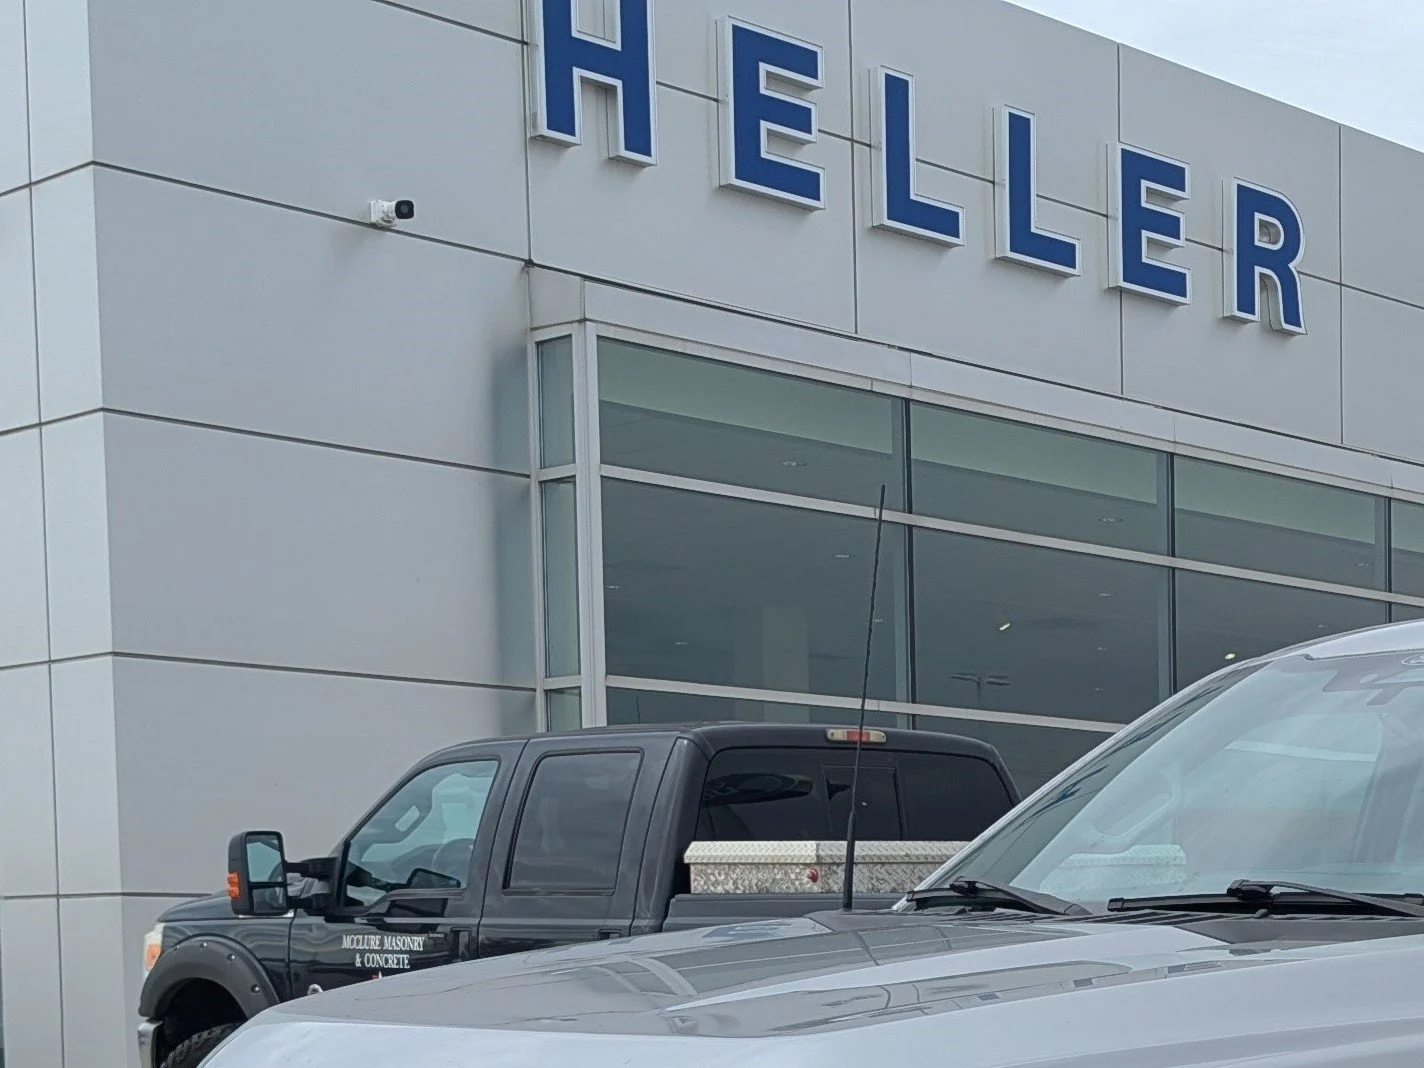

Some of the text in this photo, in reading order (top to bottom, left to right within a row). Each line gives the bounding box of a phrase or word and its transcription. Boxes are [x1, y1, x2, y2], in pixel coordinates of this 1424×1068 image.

[532, 0, 1306, 335] HELLER
[384, 935, 425, 951] MASONRY
[355, 953, 410, 969] & CONCRETE
